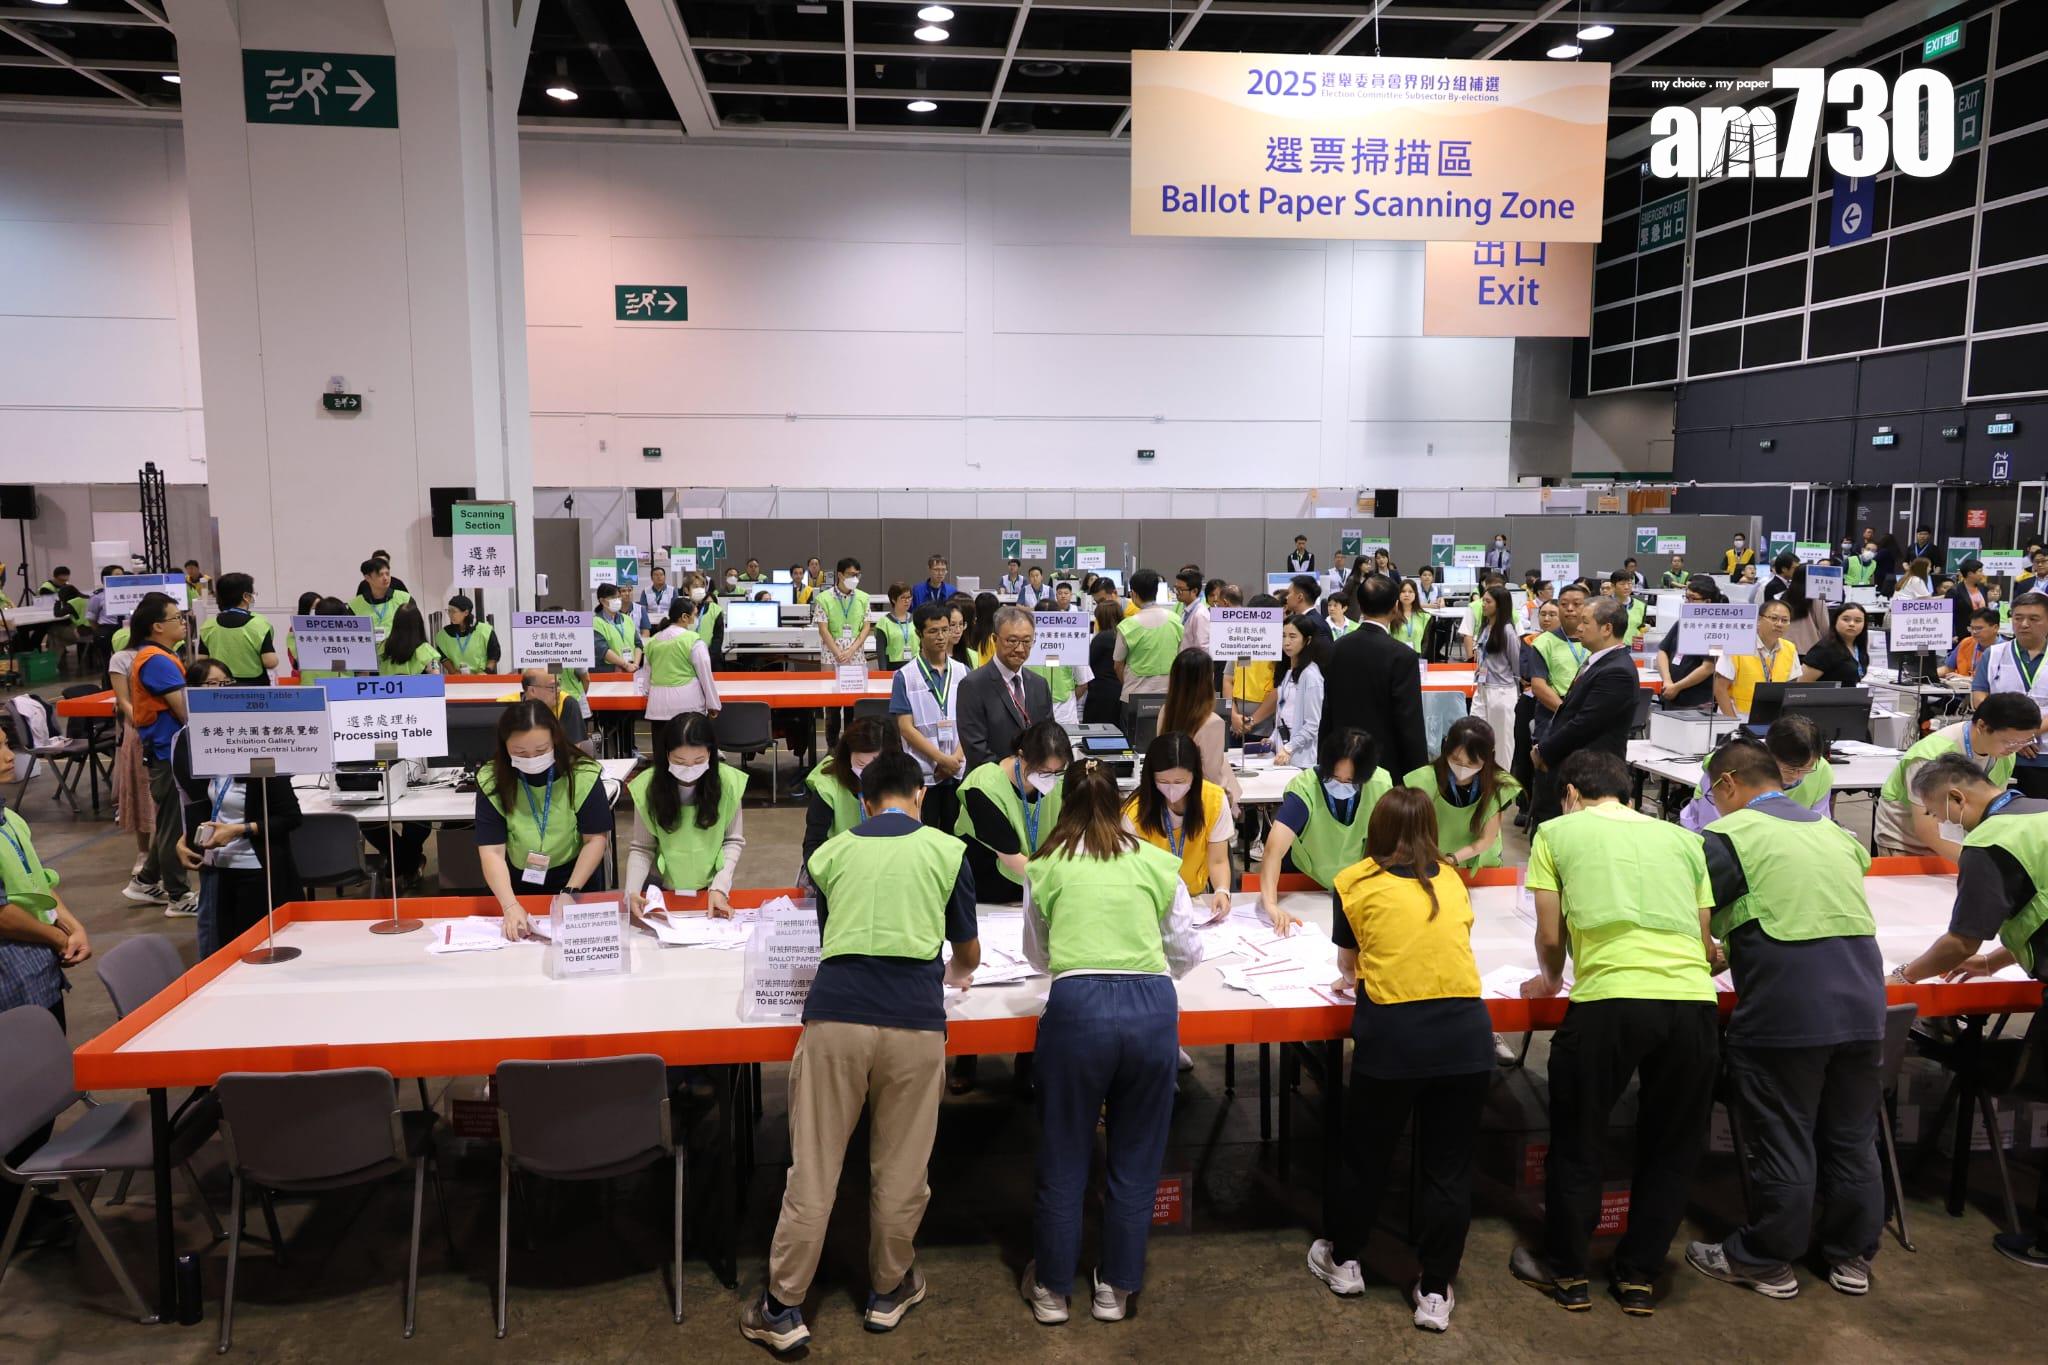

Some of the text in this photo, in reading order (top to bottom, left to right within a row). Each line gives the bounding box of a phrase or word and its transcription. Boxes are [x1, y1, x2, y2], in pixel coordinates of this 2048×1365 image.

[1247, 69, 1316, 96] 2025
[1322, 72, 1499, 92] 選舉委員會界別分組補選
[1321, 90, 1499, 102] Election Committee Subsector By-elections
[1958, 89, 1980, 113] EXIT
[1265, 136, 1473, 177] 選票掃描區
[1162, 185, 1575, 225] Ballot Paper Scanning Zone
[1479, 276, 1540, 305] Exit
[460, 510, 505, 520] Scanning
[465, 521, 501, 530] Section
[469, 546, 497, 560] 選票
[461, 564, 506, 578] 掃描部
[1694, 607, 1744, 616] BPCEM-01
[1902, 602, 1943, 611] BPCEM-01
[525, 615, 581, 624] BPCEM-03
[1222, 610, 1272, 620] BPCEM-02
[306, 620, 359, 629] BPCEM-03
[1035, 616, 1077, 625] PCEM-02
[1704, 632, 1729, 640] (ZB01)
[323, 646, 350, 654] (ZB01)
[1040, 642, 1065, 650] (ZB01)
[357, 681, 403, 695] PT-01
[213, 691, 266, 700] Processing
[268, 691, 292, 699] Table
[246, 702, 269, 710] ZB01
[201, 725, 319, 736] 香港中央圖書館展覽館
[333, 727, 433, 741] Processing Table
[268, 737, 296, 745] Gallery
[591, 920, 618, 928] PAPERS
[563, 945, 620, 955] BALLOT PAPERS
[779, 998, 804, 1006] SCANN
